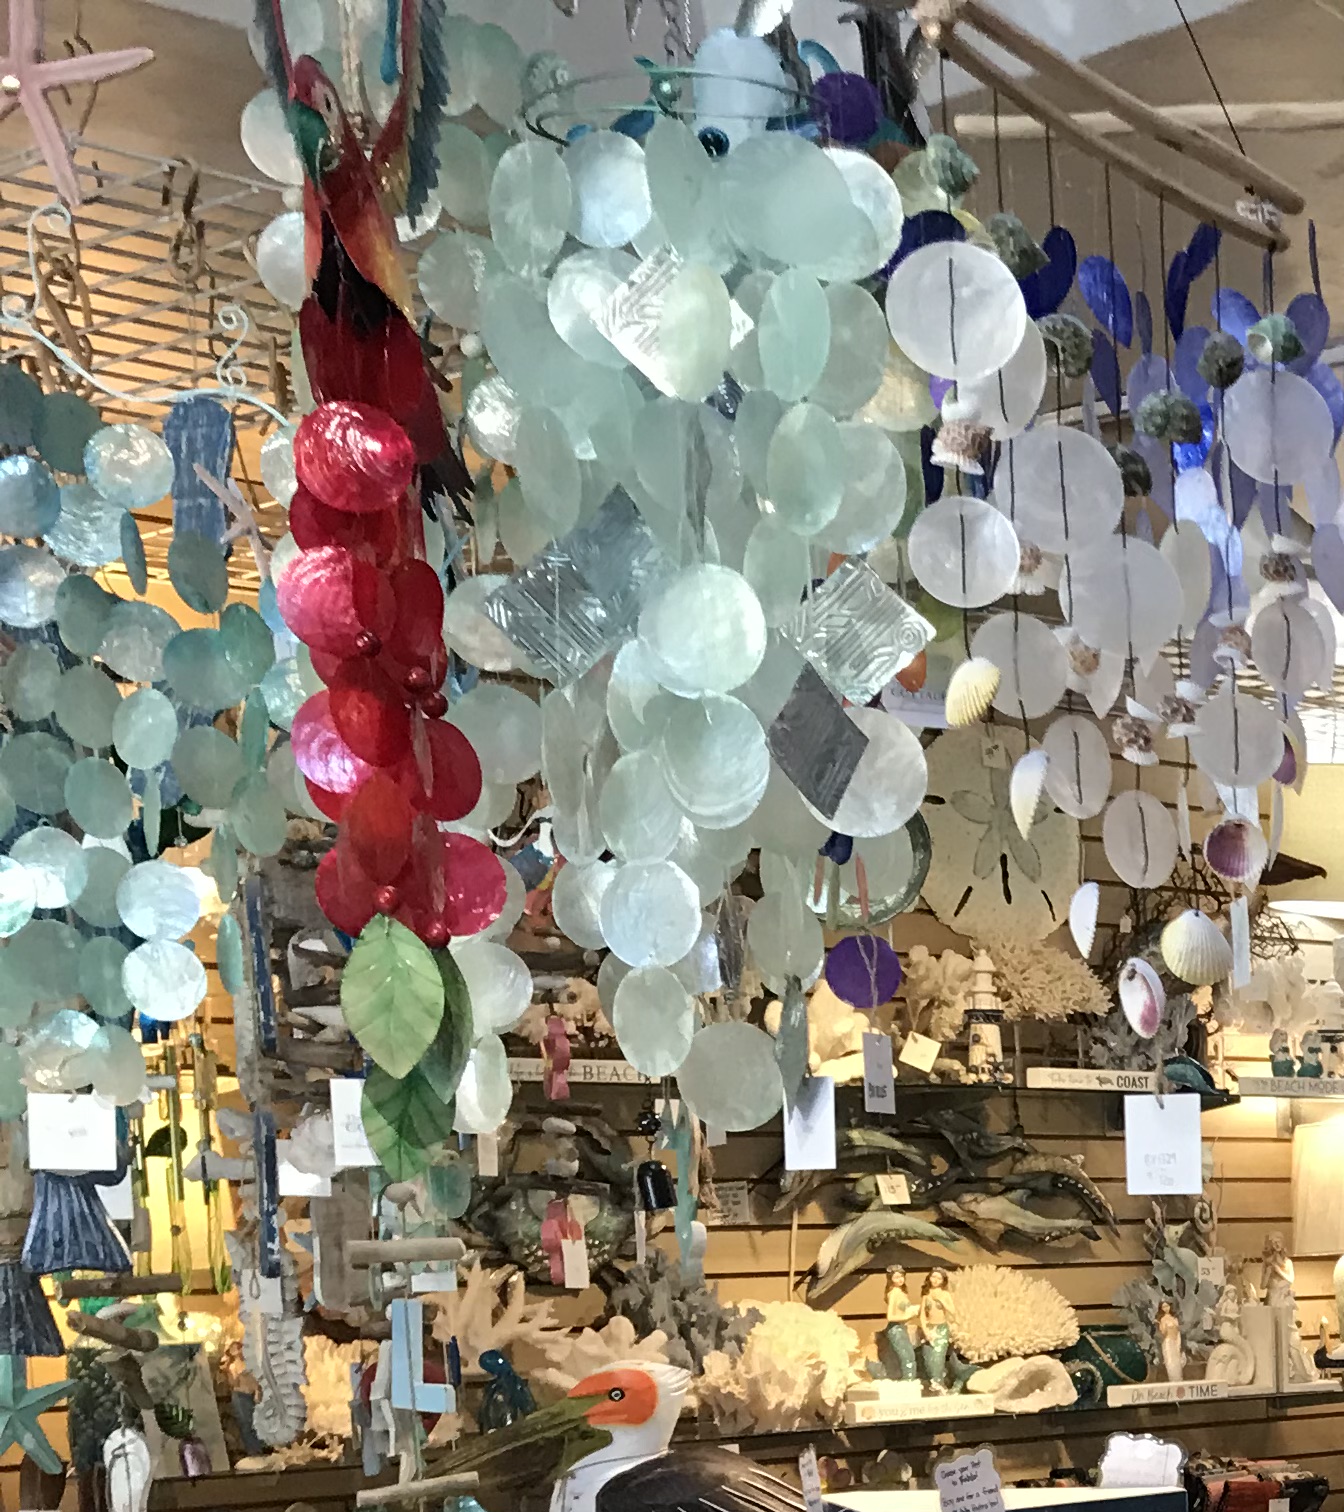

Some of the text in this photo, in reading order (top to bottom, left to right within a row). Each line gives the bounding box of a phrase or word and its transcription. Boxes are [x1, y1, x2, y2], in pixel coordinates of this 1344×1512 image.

[1116, 1075, 1149, 1089] COAST
[1270, 1079, 1339, 1094] BEACH MODE
[1188, 1384, 1218, 1398] TIME
